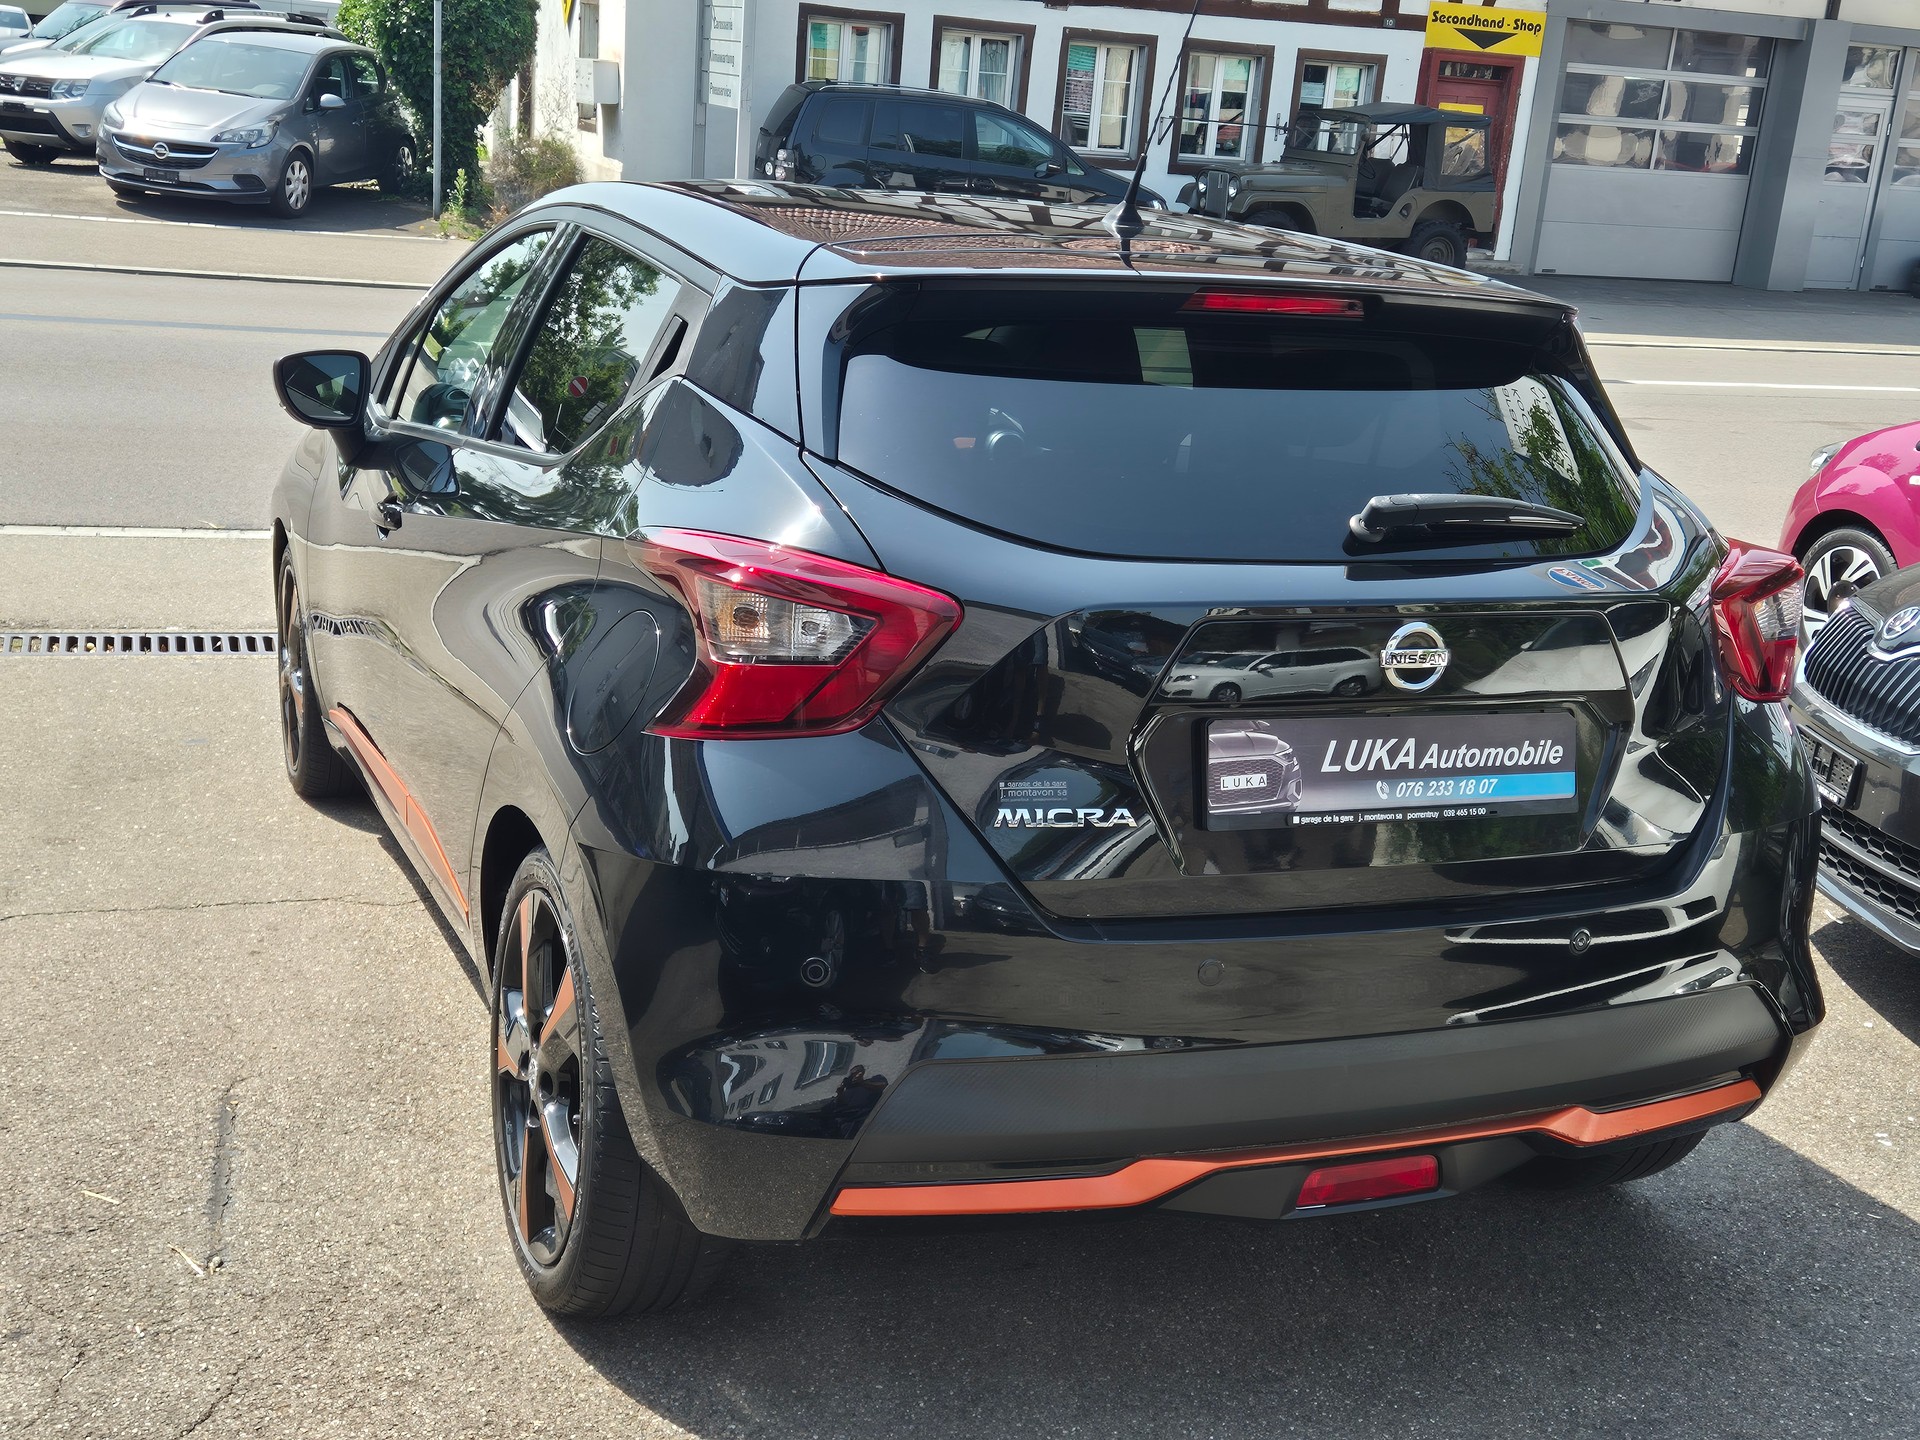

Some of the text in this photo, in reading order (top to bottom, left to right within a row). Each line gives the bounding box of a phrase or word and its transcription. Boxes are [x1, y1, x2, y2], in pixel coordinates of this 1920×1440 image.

[1431, 10, 1505, 29] Secondhand
[1513, 18, 1542, 35] Shop
[1389, 652, 1447, 665] NISSAN
[1321, 738, 1564, 772] LUKA Automobile
[1222, 776, 1266, 788] LUKA
[1396, 778, 1498, 797] 076 233 18 07
[1008, 789, 1054, 797] montavon
[993, 808, 1137, 828] MICRA
[1301, 816, 1322, 824] garage
[1340, 815, 1354, 823] gare
[1364, 813, 1394, 821] montavon
[1407, 810, 1439, 820] porrentruy
[1477, 807, 1486, 815] 00
